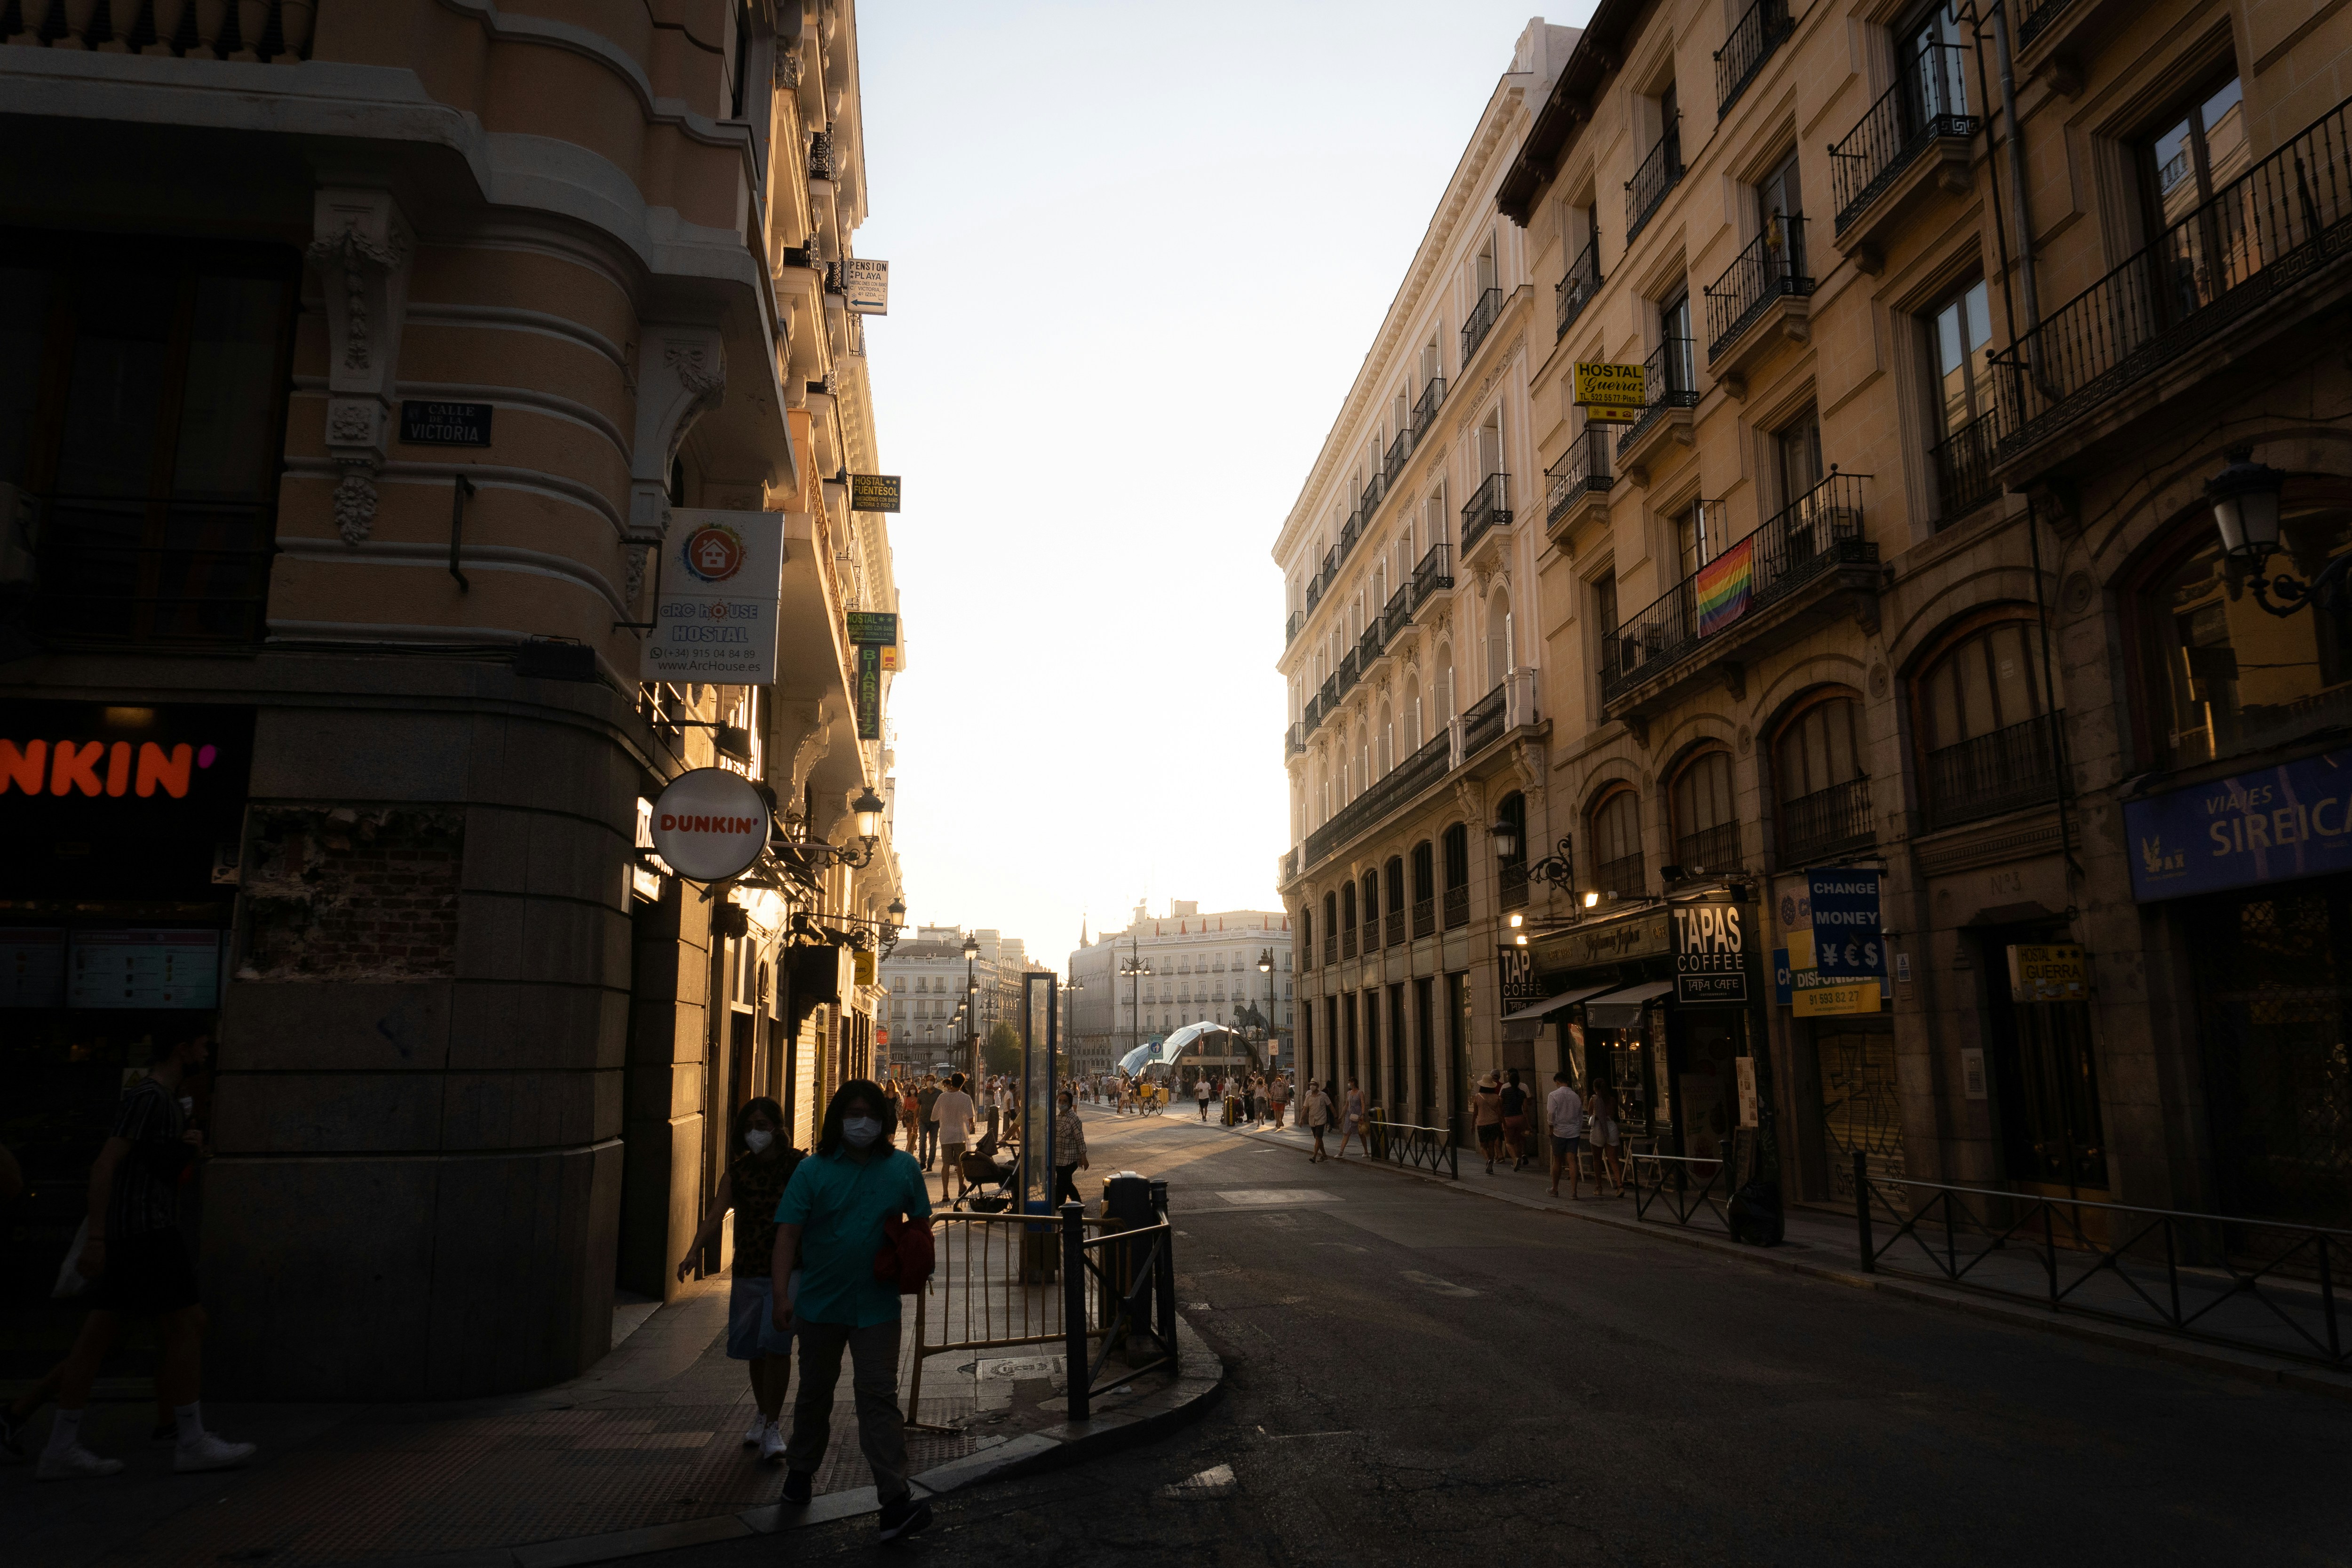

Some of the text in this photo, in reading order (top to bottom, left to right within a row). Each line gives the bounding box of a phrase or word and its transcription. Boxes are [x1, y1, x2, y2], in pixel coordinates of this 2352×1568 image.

[850, 261, 887, 271] PENSION
[855, 272, 882, 280] PLAYA
[1579, 364, 1642, 378] HOSTAL
[1584, 377, 1637, 393] Guerra
[428, 404, 475, 416] CALLE
[411, 423, 478, 442] VICTORIA
[854, 476, 885, 486] HOSTAL
[854, 486, 898, 496] FUENTESOL
[847, 613, 877, 624] HOSTAL
[672, 626, 748, 643] HOSTAL
[664, 648, 755, 659] (+34) 915 04 84 89
[658, 660, 761, 672] www.ArcHouse.es
[862, 649, 877, 735] BIARRITZ
[2205, 785, 2273, 815] VIAJES
[660, 814, 758, 835] DUNKIN'
[2209, 794, 2352, 857] SIREIC
[1813, 883, 1876, 895] CHANGE
[1815, 911, 1878, 925] MONEY
[1673, 906, 1742, 955] TAPAS
[2020, 947, 2051, 962] HOSTAL
[1677, 953, 1744, 971] COFFEE
[2026, 964, 2081, 979] GUERRA
[1503, 984, 1549, 997] COFFE
[1686, 979, 1739, 991] TAPA CAFE
[1809, 990, 1859, 1005] 91 593 82 27
